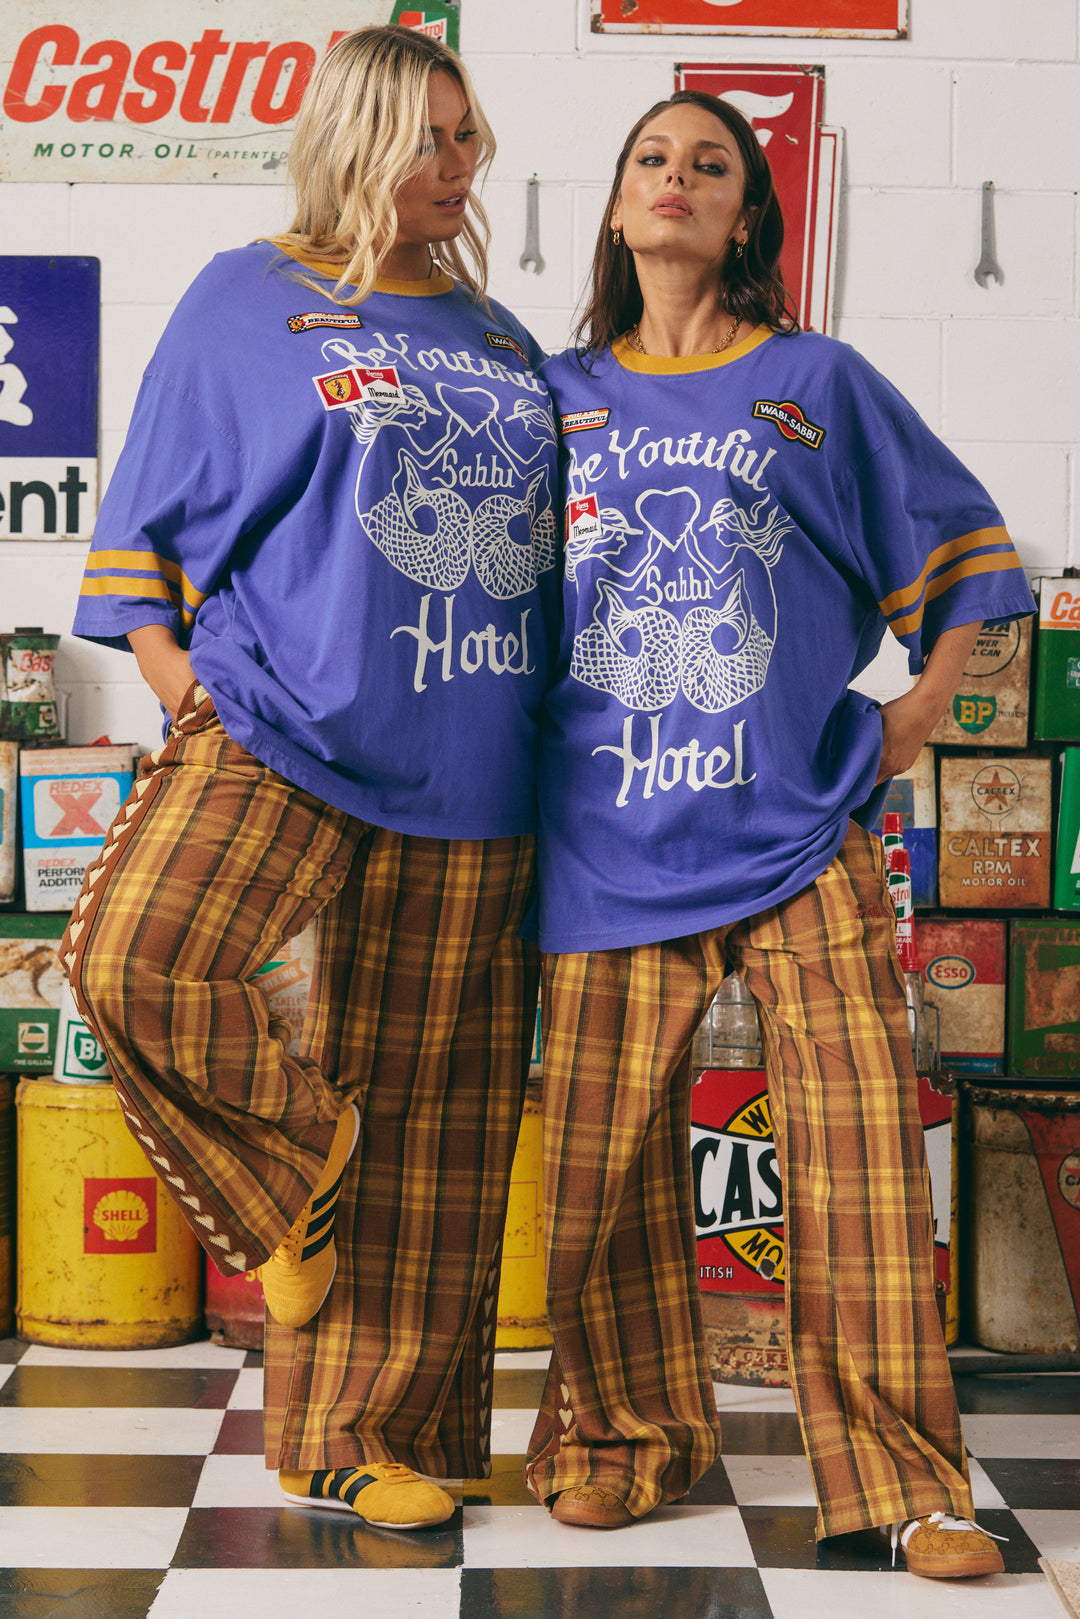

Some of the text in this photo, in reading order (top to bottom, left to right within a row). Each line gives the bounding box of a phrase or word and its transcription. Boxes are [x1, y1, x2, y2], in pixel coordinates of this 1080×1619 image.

[3, 24, 350, 124] Castro
[34, 143, 134, 158] MOTOR
[155, 143, 198, 159] OIL
[565, 415, 606, 428] BEAUTIFUL
[760, 404, 817, 442] WABI-SABBI
[608, 426, 777, 491] Youtiful
[0, 466, 87, 533] nt
[389, 592, 536, 693] Hotel
[980, 649, 1001, 657] CAN
[959, 701, 993, 724] BP
[591, 713, 757, 808] Hotel
[49, 780, 103, 795] REDEX
[977, 787, 1015, 796] CALTEX
[948, 837, 1042, 858] CALTEX
[972, 860, 1012, 875] RPM
[961, 877, 1027, 888] MOTOR OIL
[102, 1209, 142, 1221] SHELL
